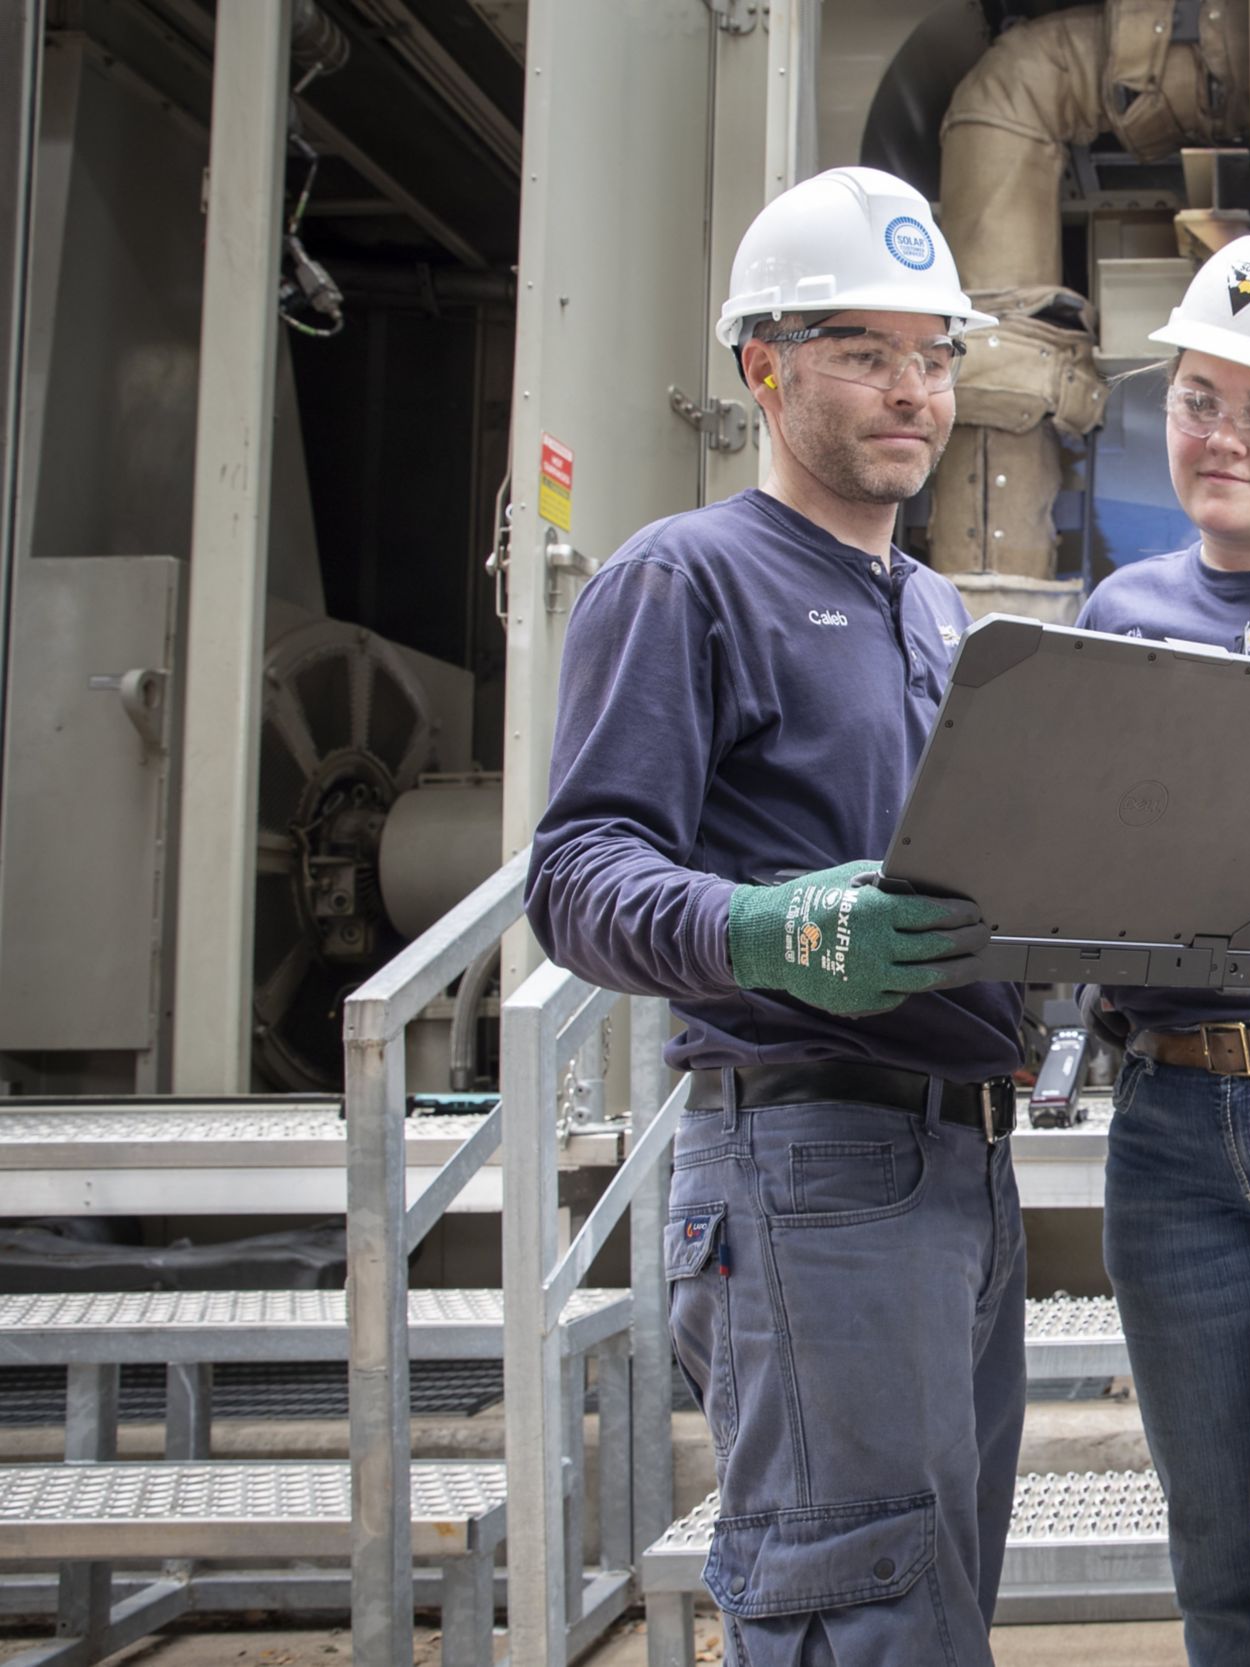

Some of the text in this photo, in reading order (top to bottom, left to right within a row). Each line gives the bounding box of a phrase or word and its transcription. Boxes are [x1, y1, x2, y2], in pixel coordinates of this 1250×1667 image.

[896, 235, 925, 247] SOLAR
[808, 610, 848, 627] Caleb
[835, 889, 860, 974] MaxiFlex
